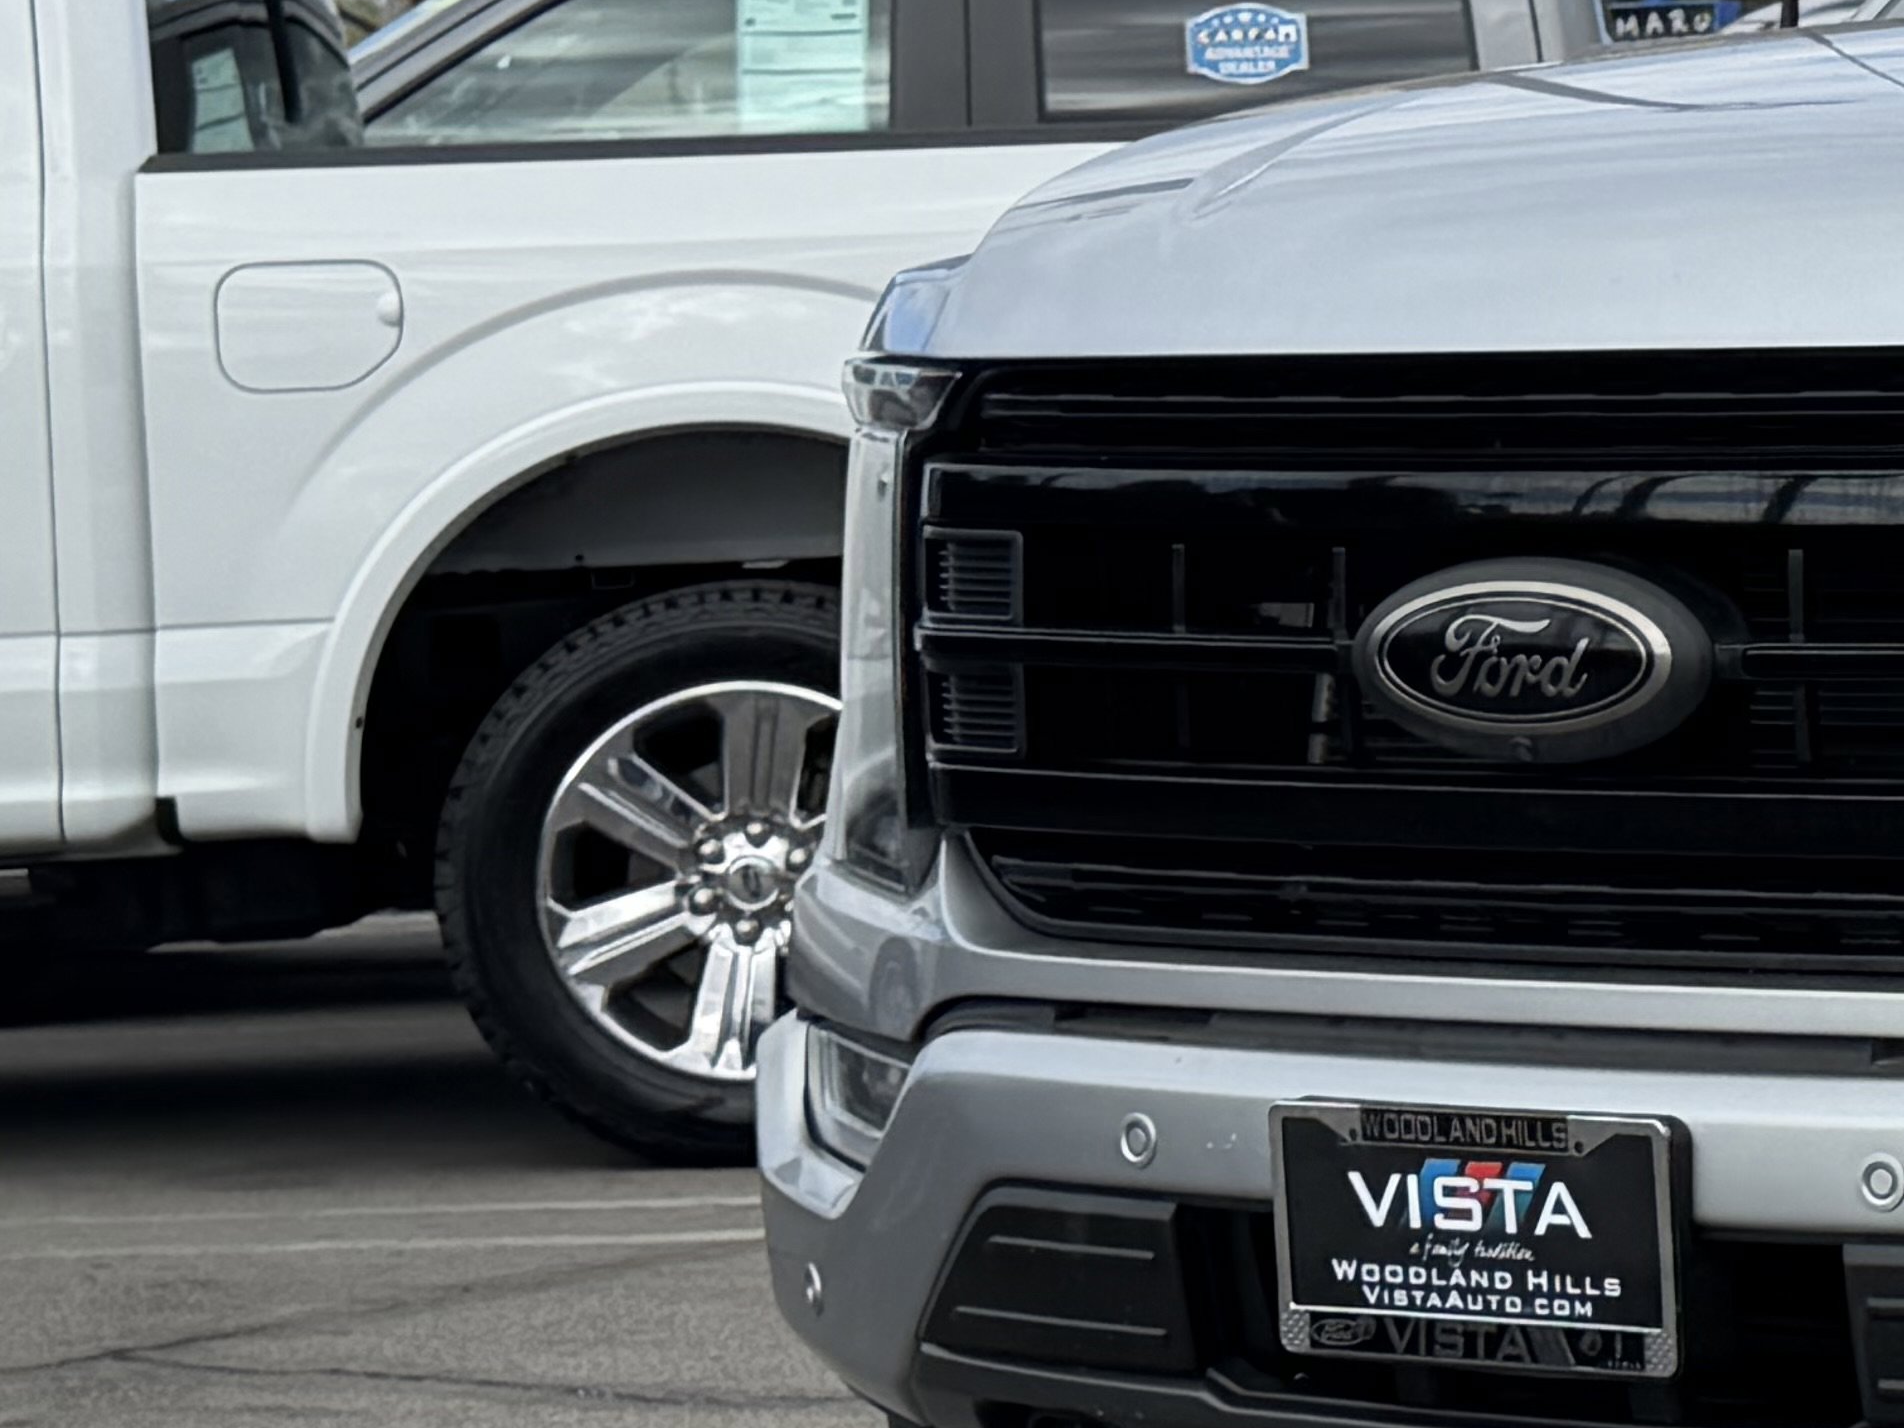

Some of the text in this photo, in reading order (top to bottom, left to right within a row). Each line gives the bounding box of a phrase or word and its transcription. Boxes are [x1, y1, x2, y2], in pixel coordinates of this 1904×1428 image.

[1430, 614, 1589, 698] Ford
[1361, 1110, 1568, 1151] WOODLAND HILLS
[1348, 1171, 1592, 1239] VISTA
[1422, 1232, 1470, 1268] family
[1331, 1258, 1622, 1297] WOODLAND HILLS
[1385, 1316, 1533, 1364] VISTA
